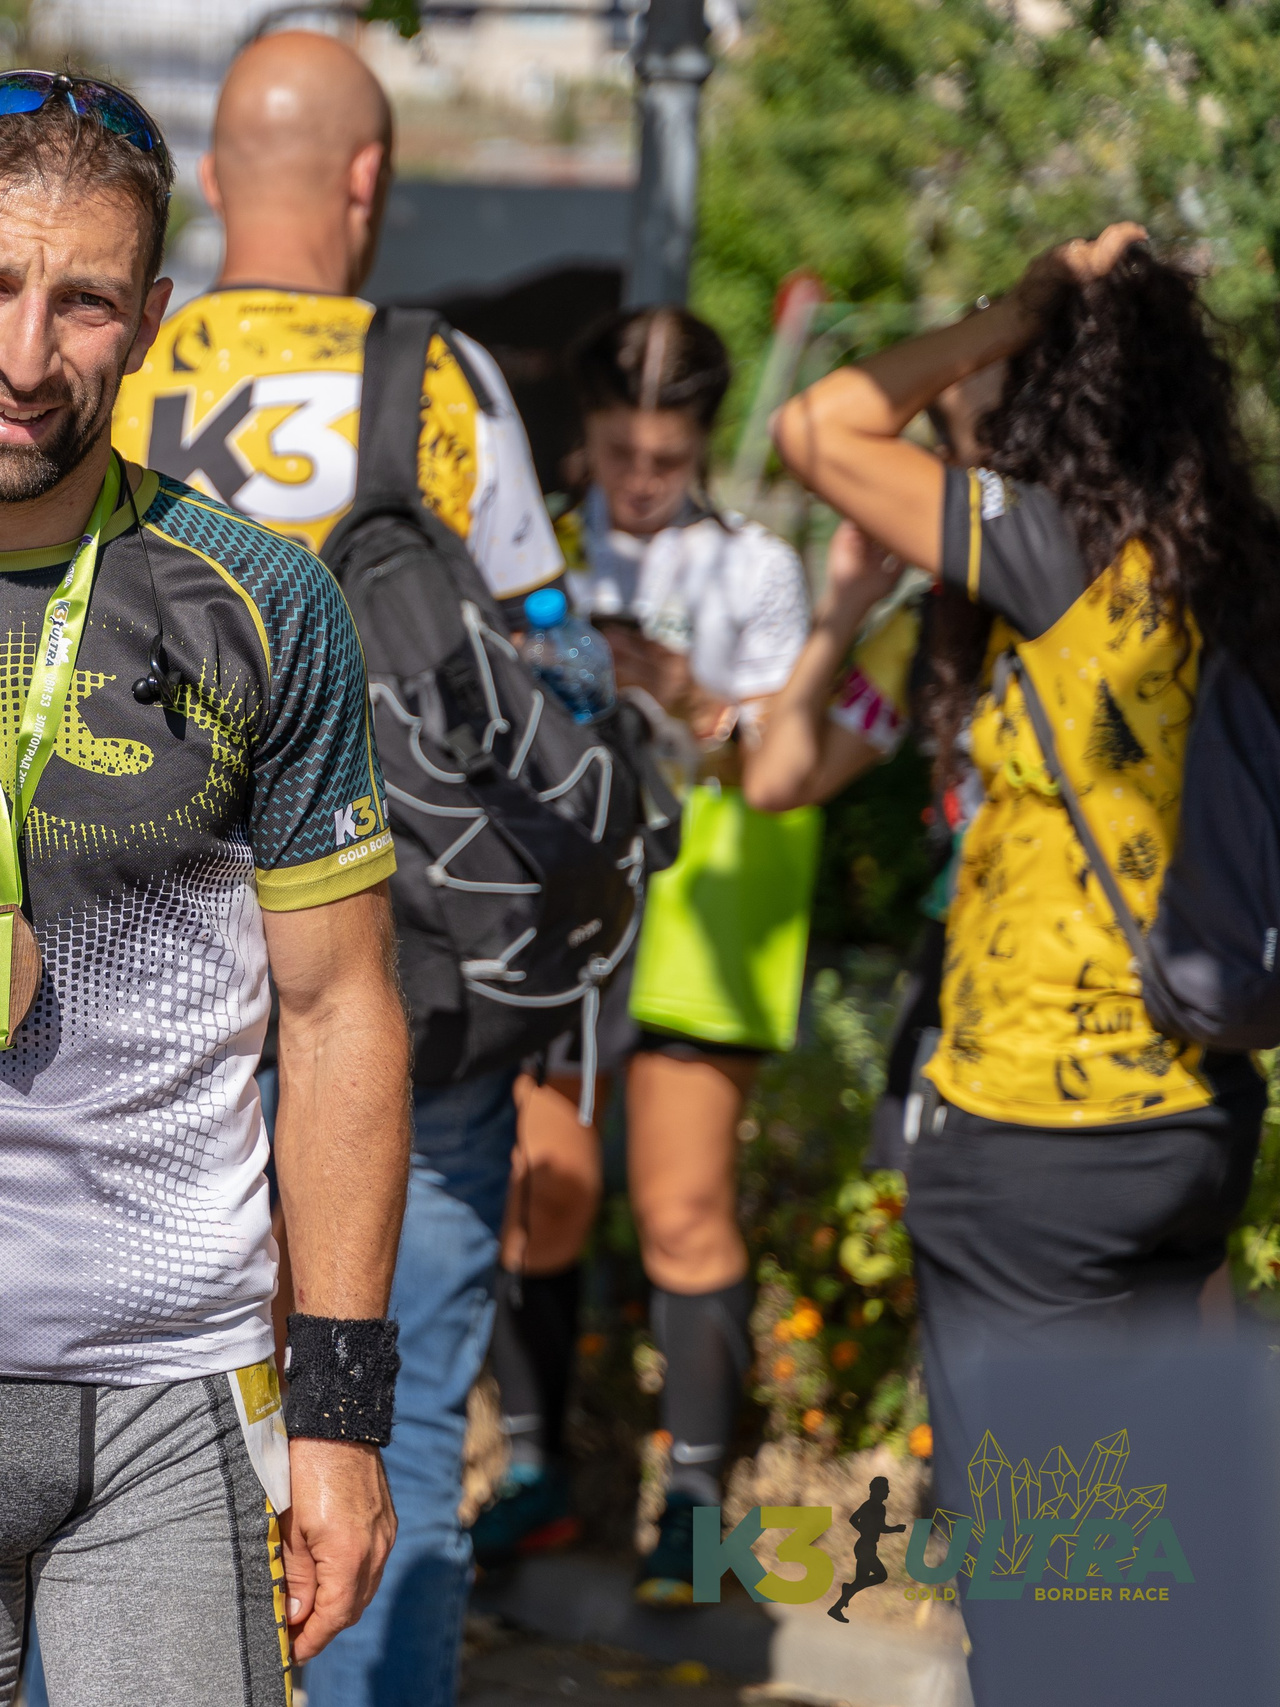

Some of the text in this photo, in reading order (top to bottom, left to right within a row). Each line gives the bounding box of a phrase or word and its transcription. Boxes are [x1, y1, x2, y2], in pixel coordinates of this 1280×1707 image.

[148, 370, 363, 521] K3
[45, 626, 61, 667] ULTRA
[334, 795, 377, 846] K3
[338, 847, 369, 865] GOLD
